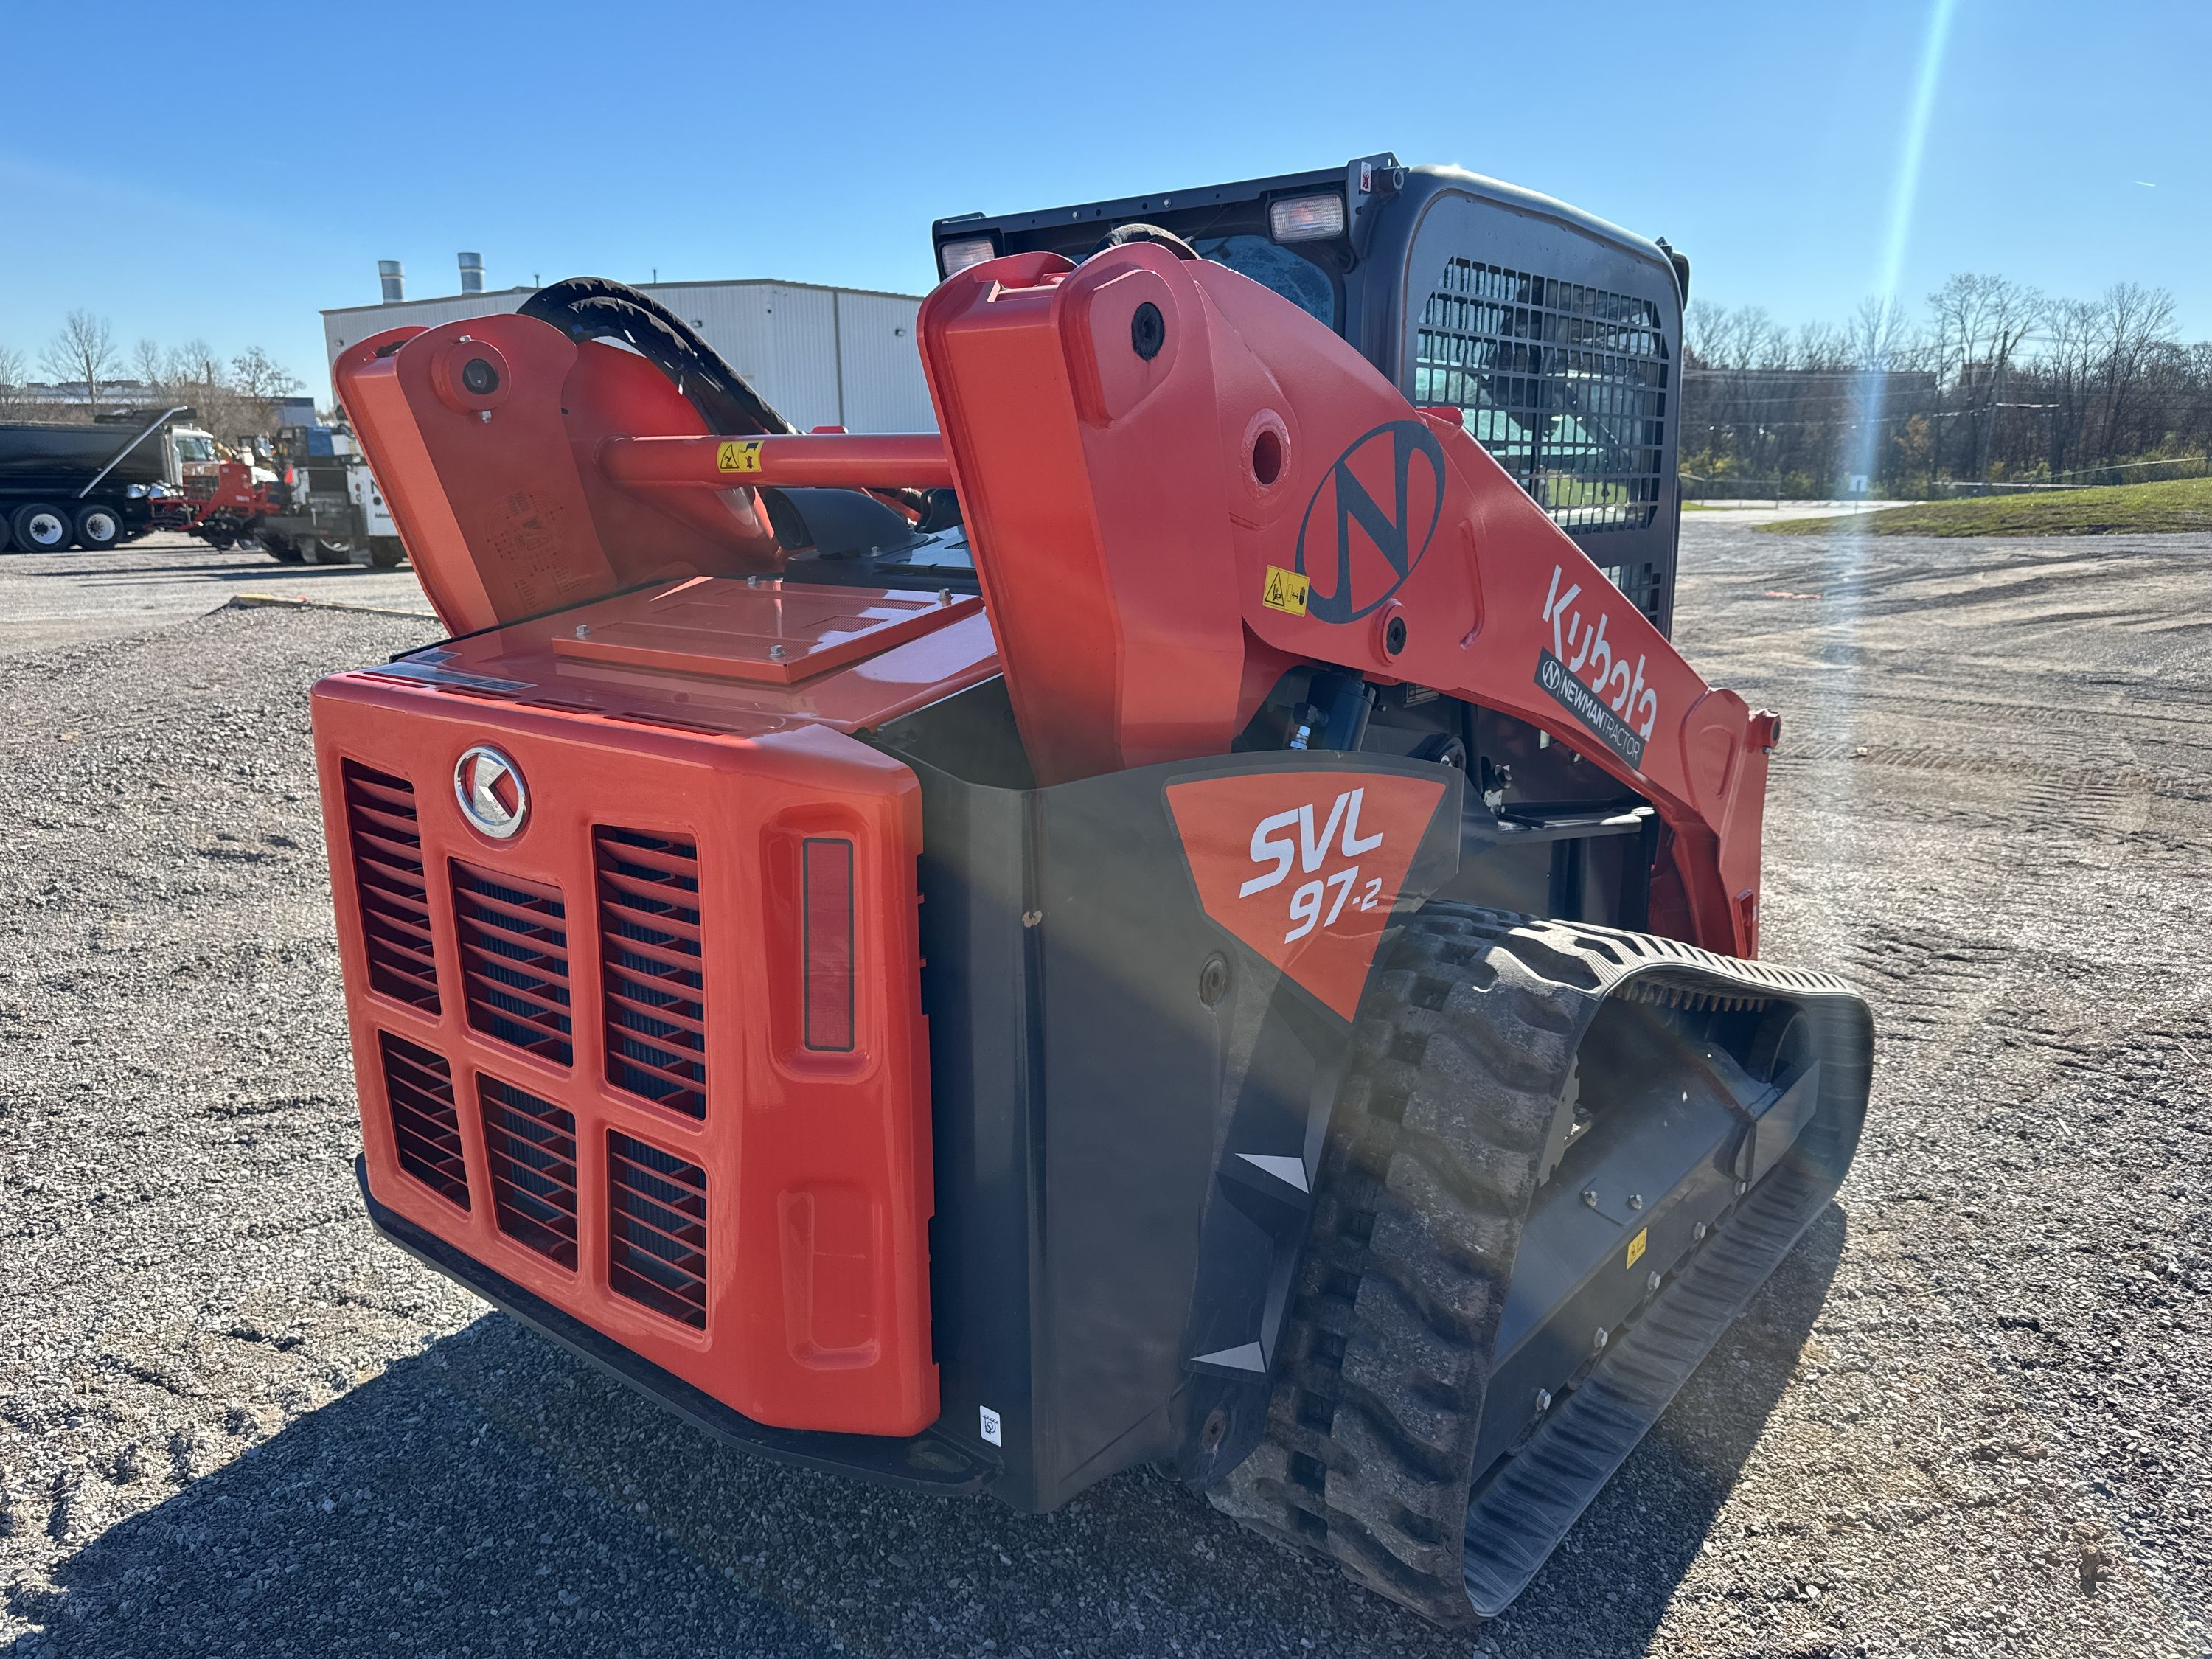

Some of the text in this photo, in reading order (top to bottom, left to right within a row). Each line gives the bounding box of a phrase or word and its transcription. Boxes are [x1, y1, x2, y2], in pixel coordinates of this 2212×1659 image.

[1543, 564, 1658, 742] Kubota
[1239, 787, 1383, 898] SVL
[1284, 865, 1382, 944] 97-2
